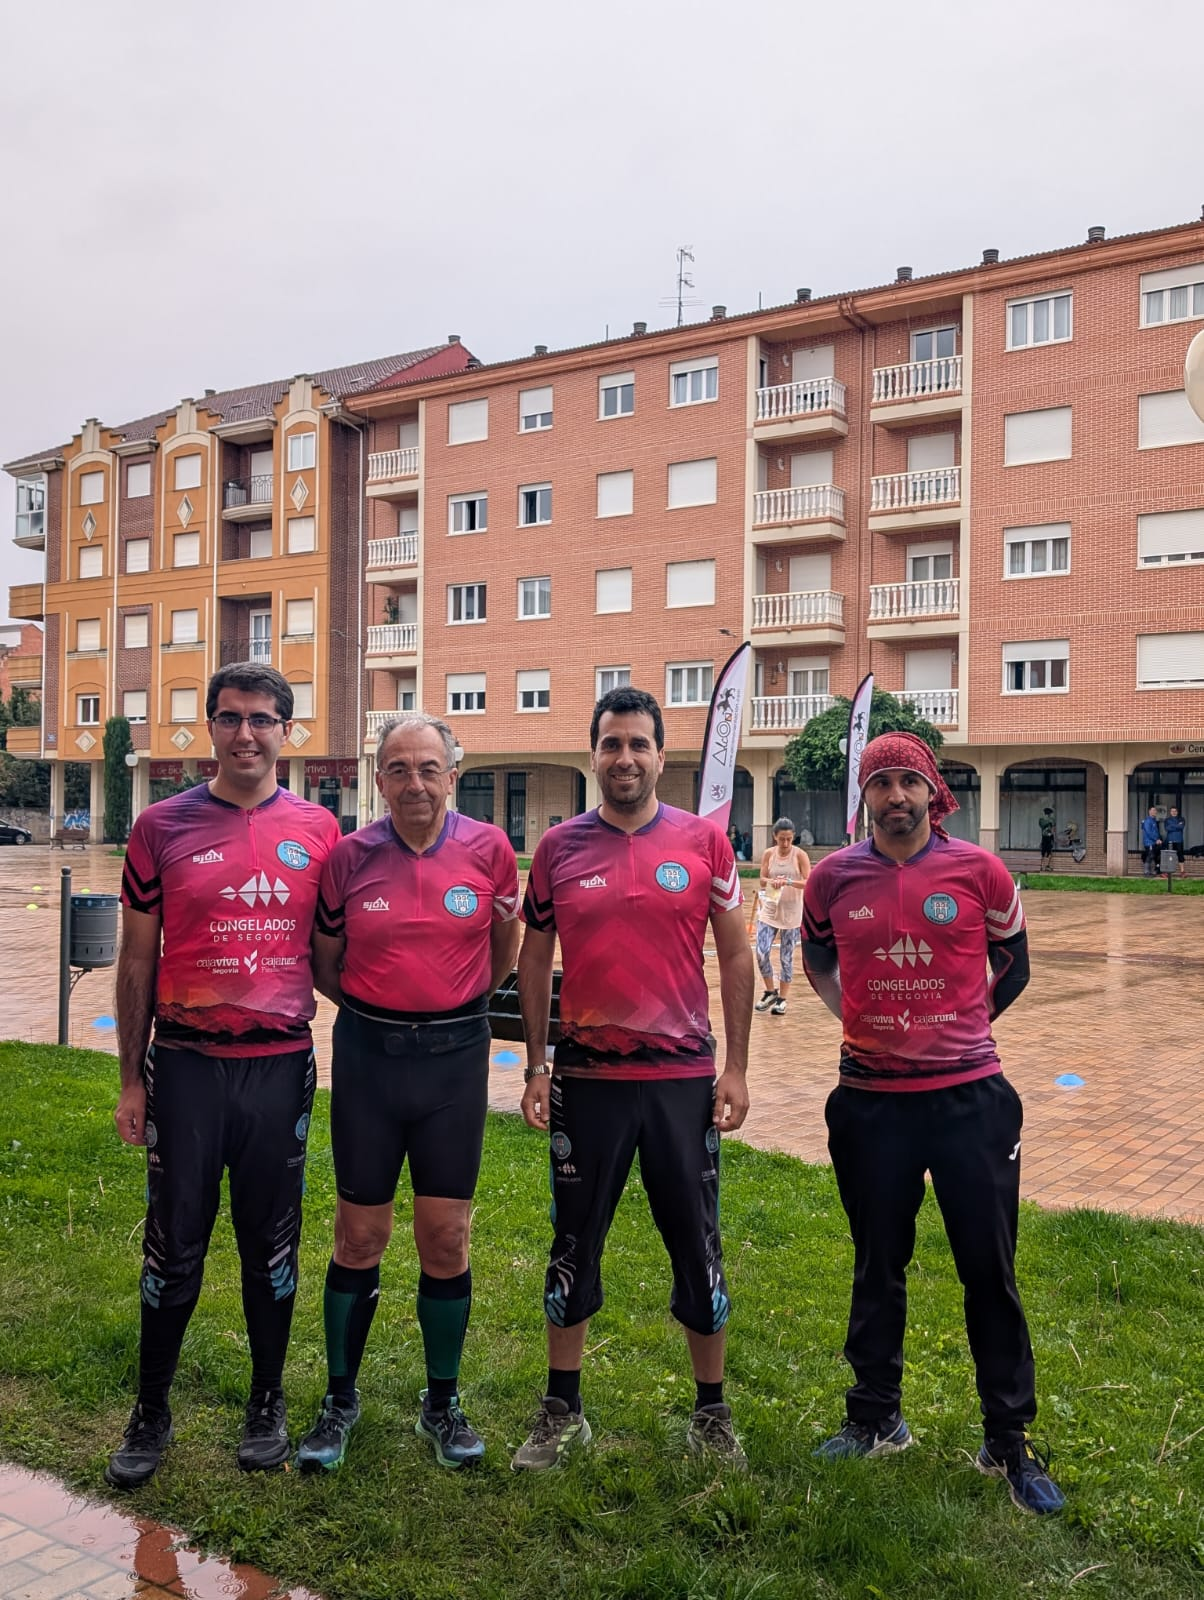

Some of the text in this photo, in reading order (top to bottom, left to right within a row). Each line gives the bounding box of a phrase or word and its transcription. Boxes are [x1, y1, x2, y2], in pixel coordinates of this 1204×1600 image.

[209, 918, 296, 932] CONGELADOS
[213, 933, 290, 943] DE SEGOVIA
[197, 956, 239, 969] cajaviva
[867, 979, 945, 991] CONGELADOS
[891, 992, 941, 1000] SEGOVIA
[913, 1011, 957, 1026] cajarural
